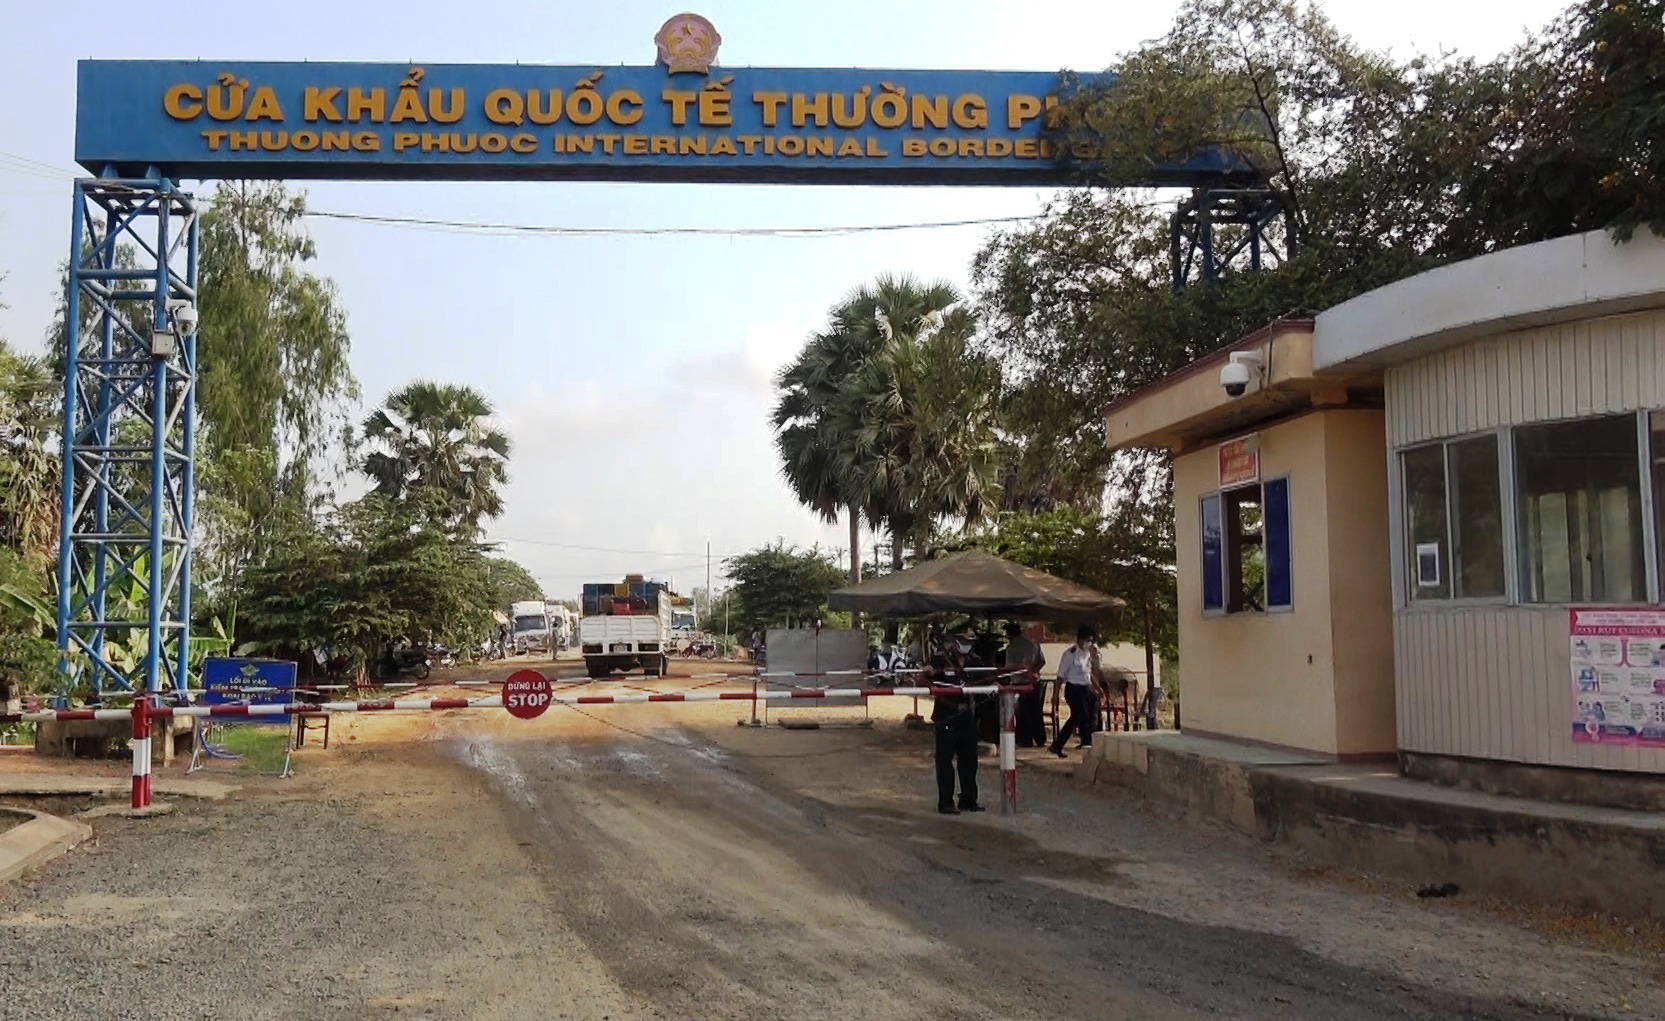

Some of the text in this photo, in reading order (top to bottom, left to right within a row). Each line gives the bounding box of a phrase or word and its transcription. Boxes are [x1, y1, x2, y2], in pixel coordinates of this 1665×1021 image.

[163, 72, 284, 122] CỬA
[303, 66, 465, 124] KHẨU
[484, 71, 644, 126] QUỐC
[662, 76, 734, 126] TẾ
[753, 82, 988, 129] THƯỜNG
[201, 130, 380, 151] THUONG
[393, 132, 538, 153] PHUOC
[553, 134, 888, 158] INTERNATIONAL
[508, 692, 548, 708] STOP
